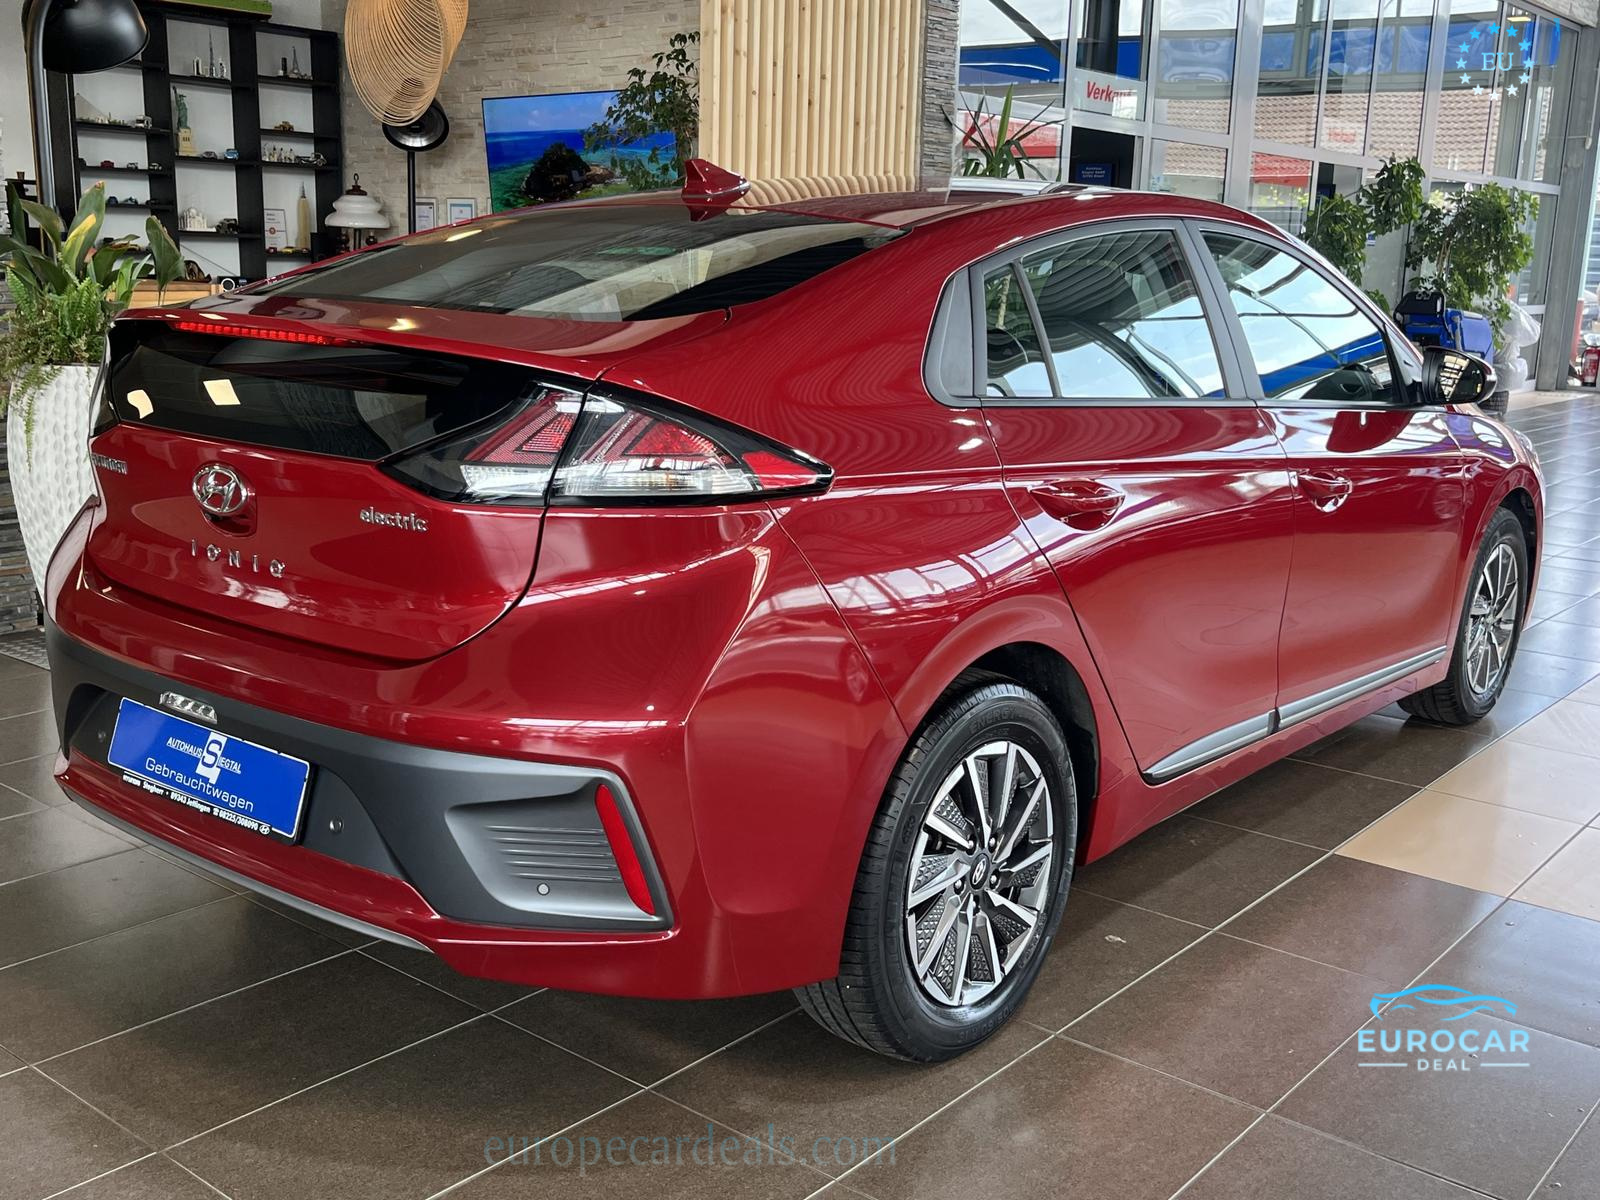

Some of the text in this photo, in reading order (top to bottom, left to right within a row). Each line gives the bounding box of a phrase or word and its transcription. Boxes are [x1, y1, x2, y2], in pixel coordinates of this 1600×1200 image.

[360, 506, 428, 533] electric
[191, 538, 286, 578] IONIQ
[166, 737, 204, 758] AUTOHAUS
[145, 757, 254, 813] Gebrauchtwagen
